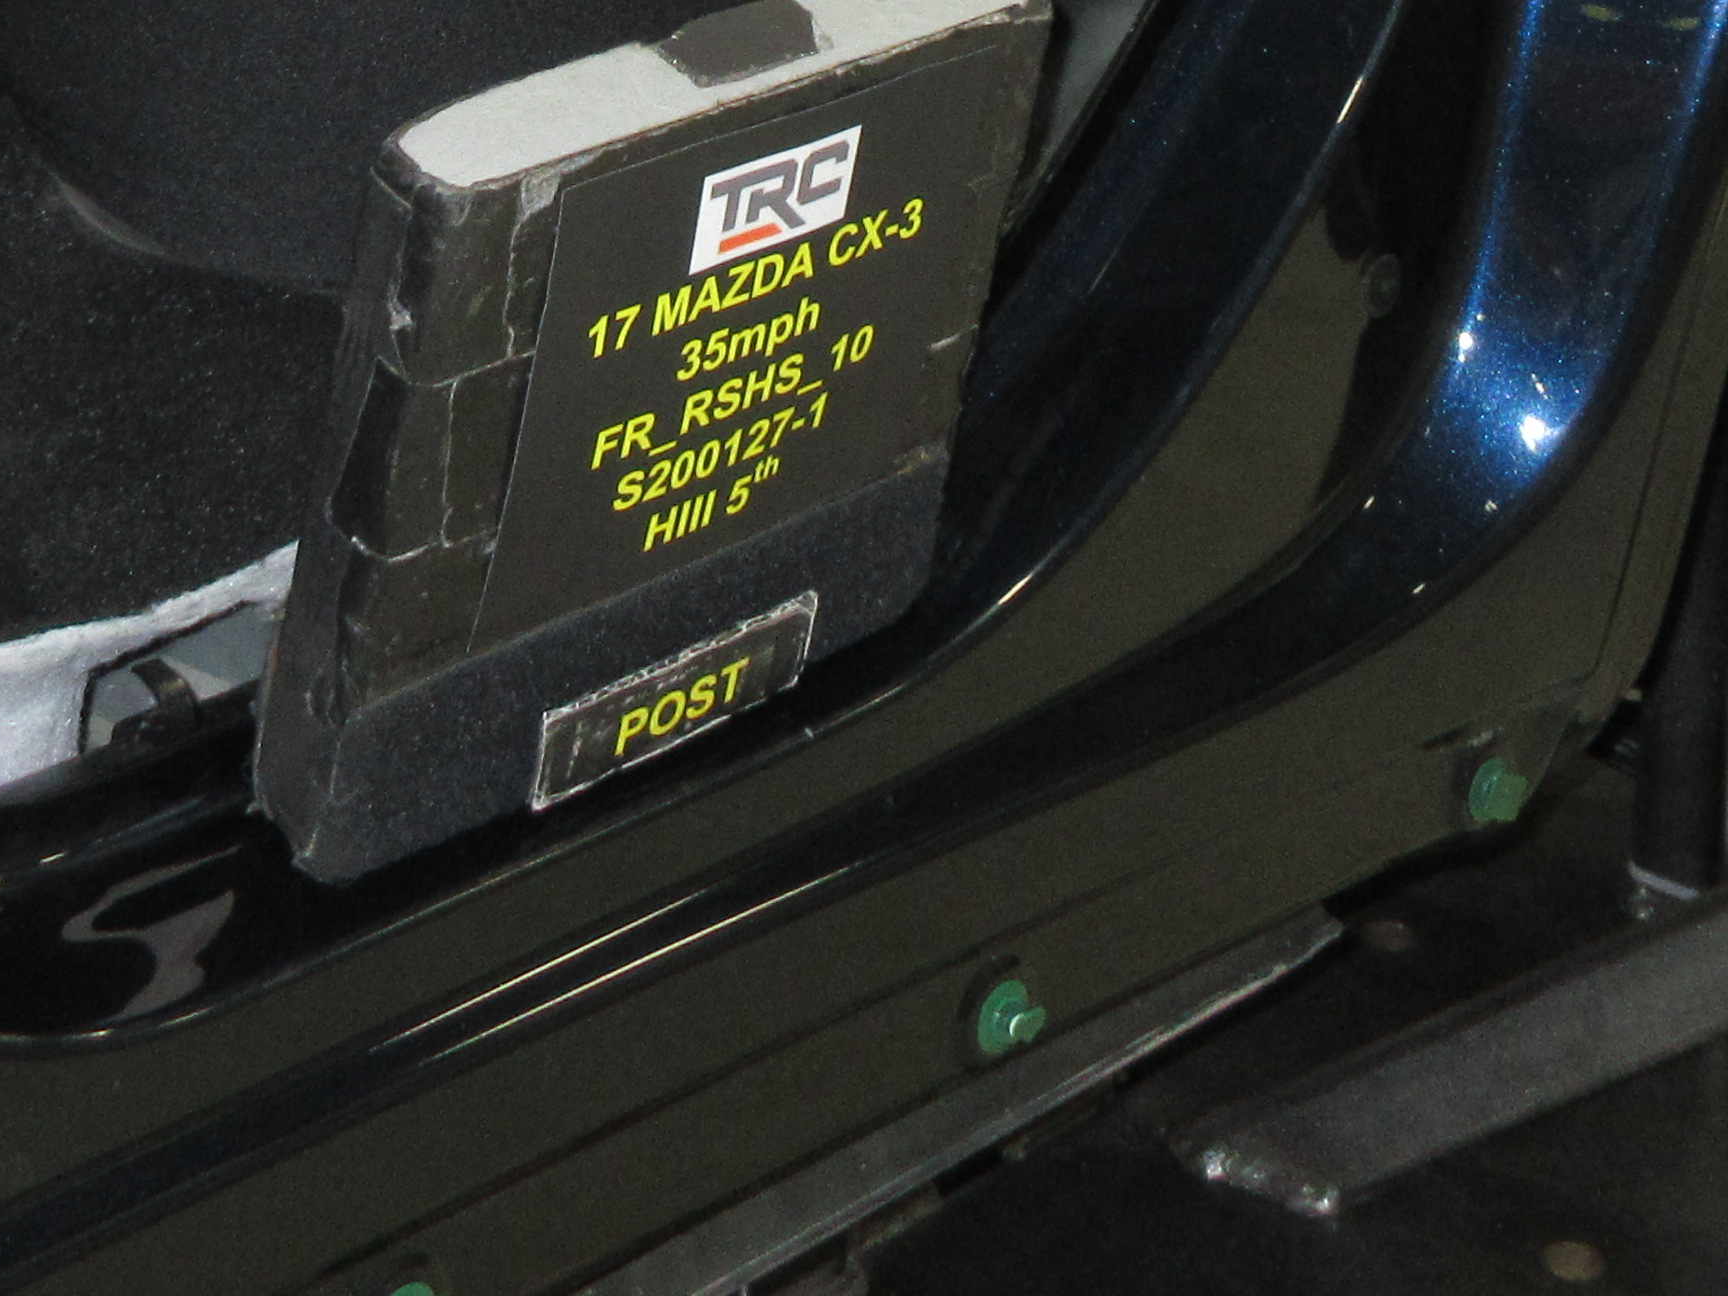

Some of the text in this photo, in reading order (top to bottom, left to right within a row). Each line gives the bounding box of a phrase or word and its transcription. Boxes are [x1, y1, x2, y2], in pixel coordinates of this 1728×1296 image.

[708, 141, 851, 230] TRC
[587, 197, 926, 359] 17 MAZDA CX-3
[674, 295, 824, 382] 35mph
[590, 323, 877, 471] FR_RSHS_ 10
[611, 391, 830, 512] S200127-1
[642, 454, 783, 552] HIII 5th
[614, 656, 752, 756] POST
